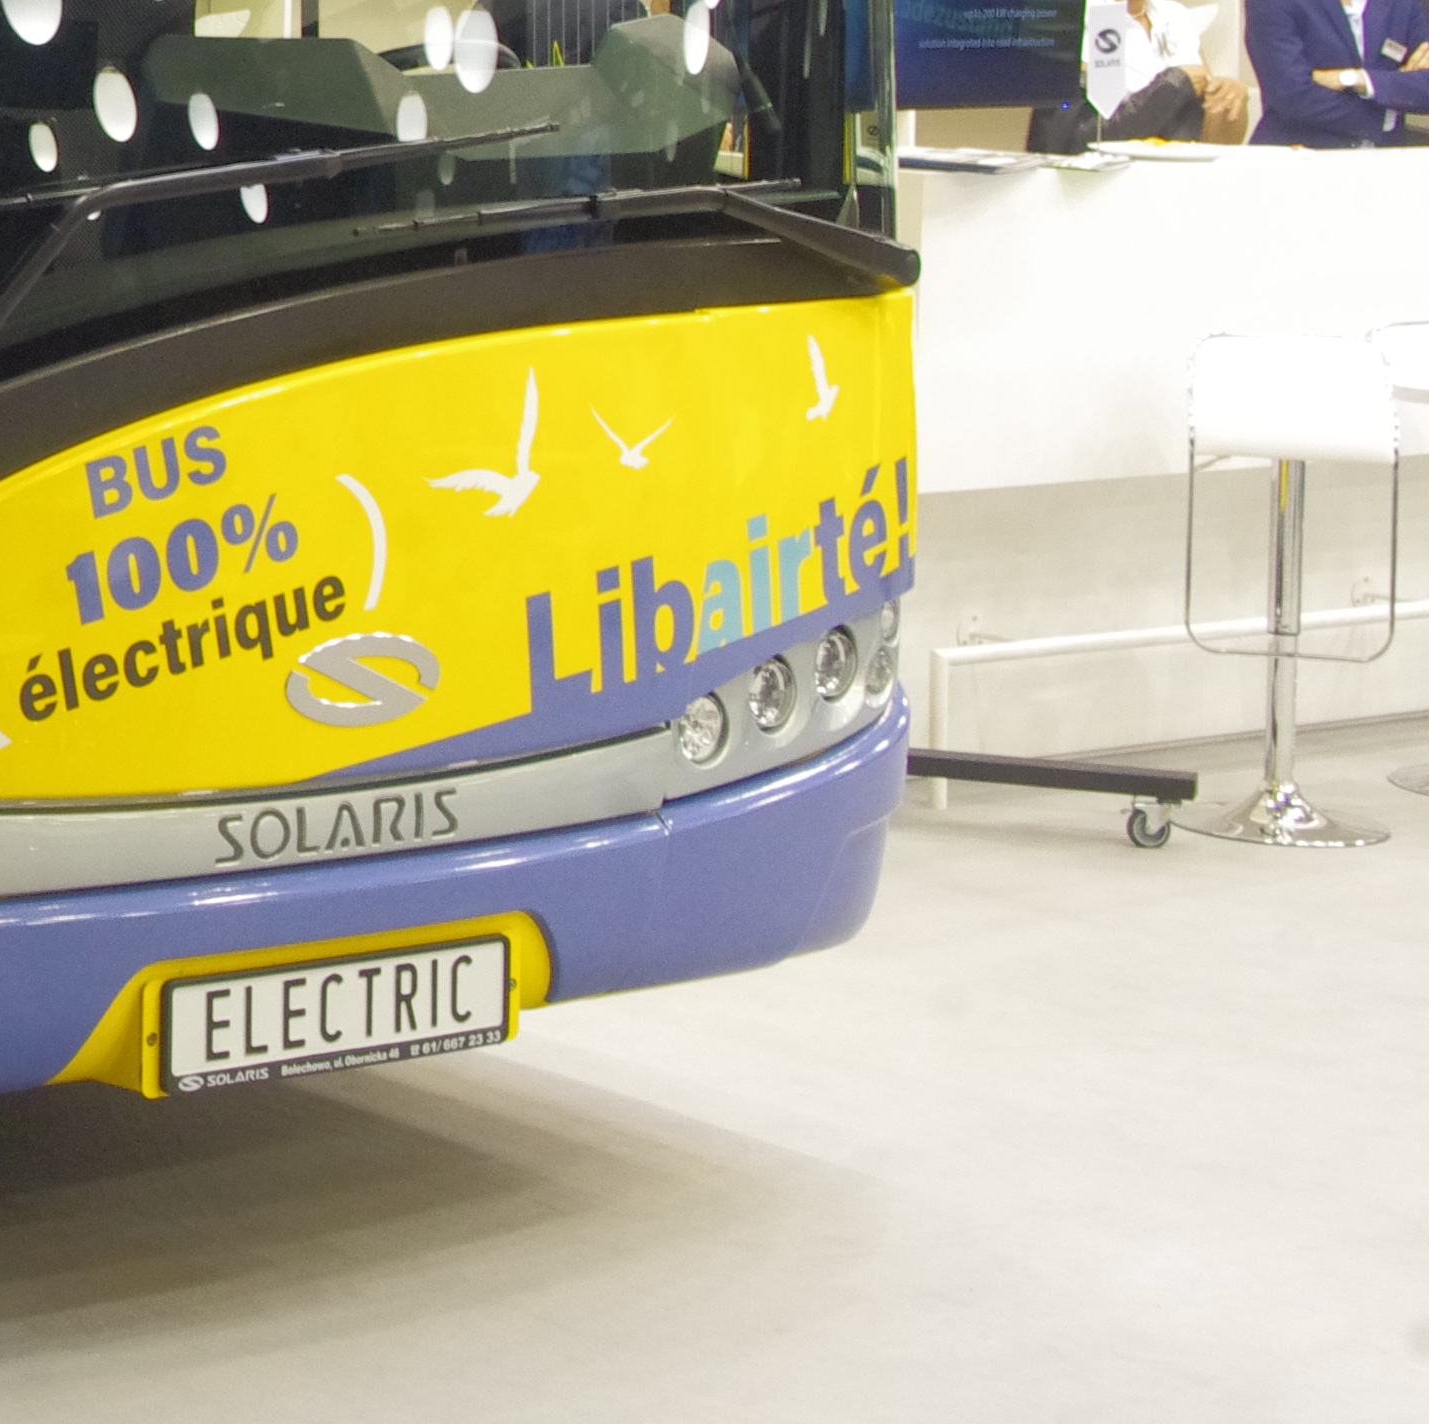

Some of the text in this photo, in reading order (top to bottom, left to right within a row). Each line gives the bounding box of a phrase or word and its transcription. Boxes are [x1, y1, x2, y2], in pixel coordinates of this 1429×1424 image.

[85, 424, 228, 520] BUS
[66, 492, 299, 626] 100%
[526, 456, 913, 696] Libairté!
[18, 574, 347, 723] électrique
[214, 787, 460, 867] SOLARIS
[205, 954, 473, 1063] ELECTRIC
[206, 1067, 269, 1088] SOLARIS
[468, 1034, 483, 1047] 23
[486, 1029, 501, 1044] 33
